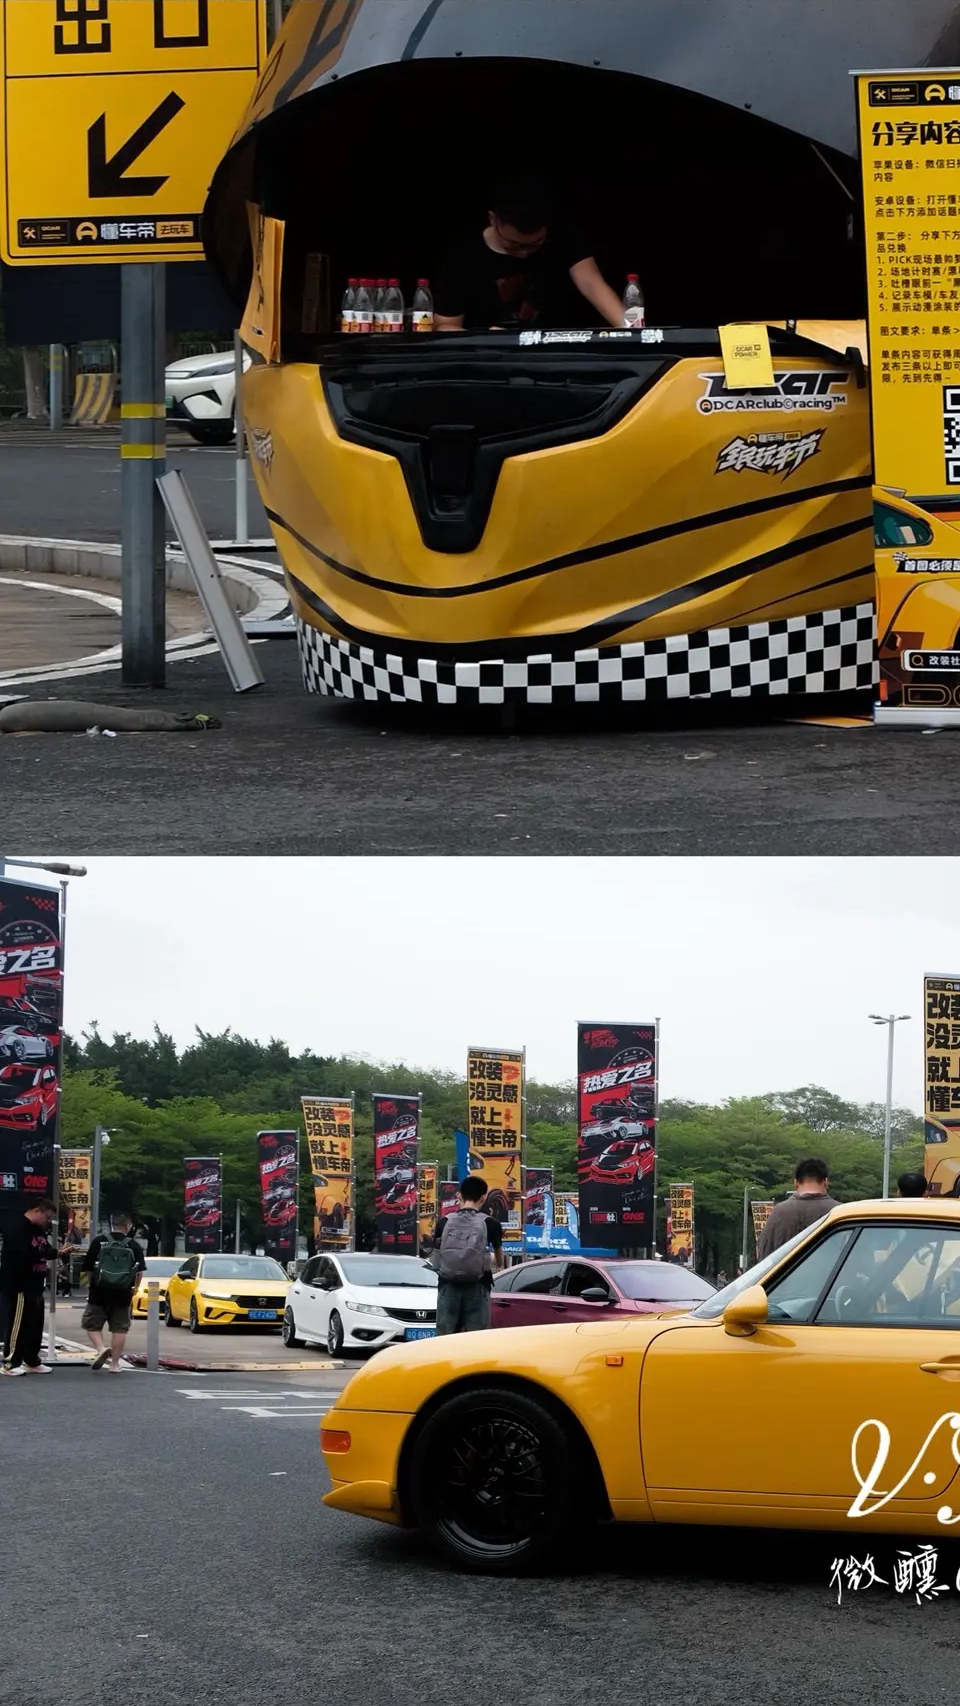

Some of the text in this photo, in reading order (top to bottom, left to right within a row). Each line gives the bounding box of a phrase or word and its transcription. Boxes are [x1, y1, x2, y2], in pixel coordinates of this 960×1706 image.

[874, 173, 893, 183] 内容
[100, 222, 154, 240] 懂车帝
[160, 224, 190, 235] 去玩车
[718, 434, 821, 475] 全民玩车节
[583, 1061, 652, 1093] 热爱之名
[470, 1082, 518, 1103] 没灵感
[471, 1129, 517, 1148] 懂车帝
